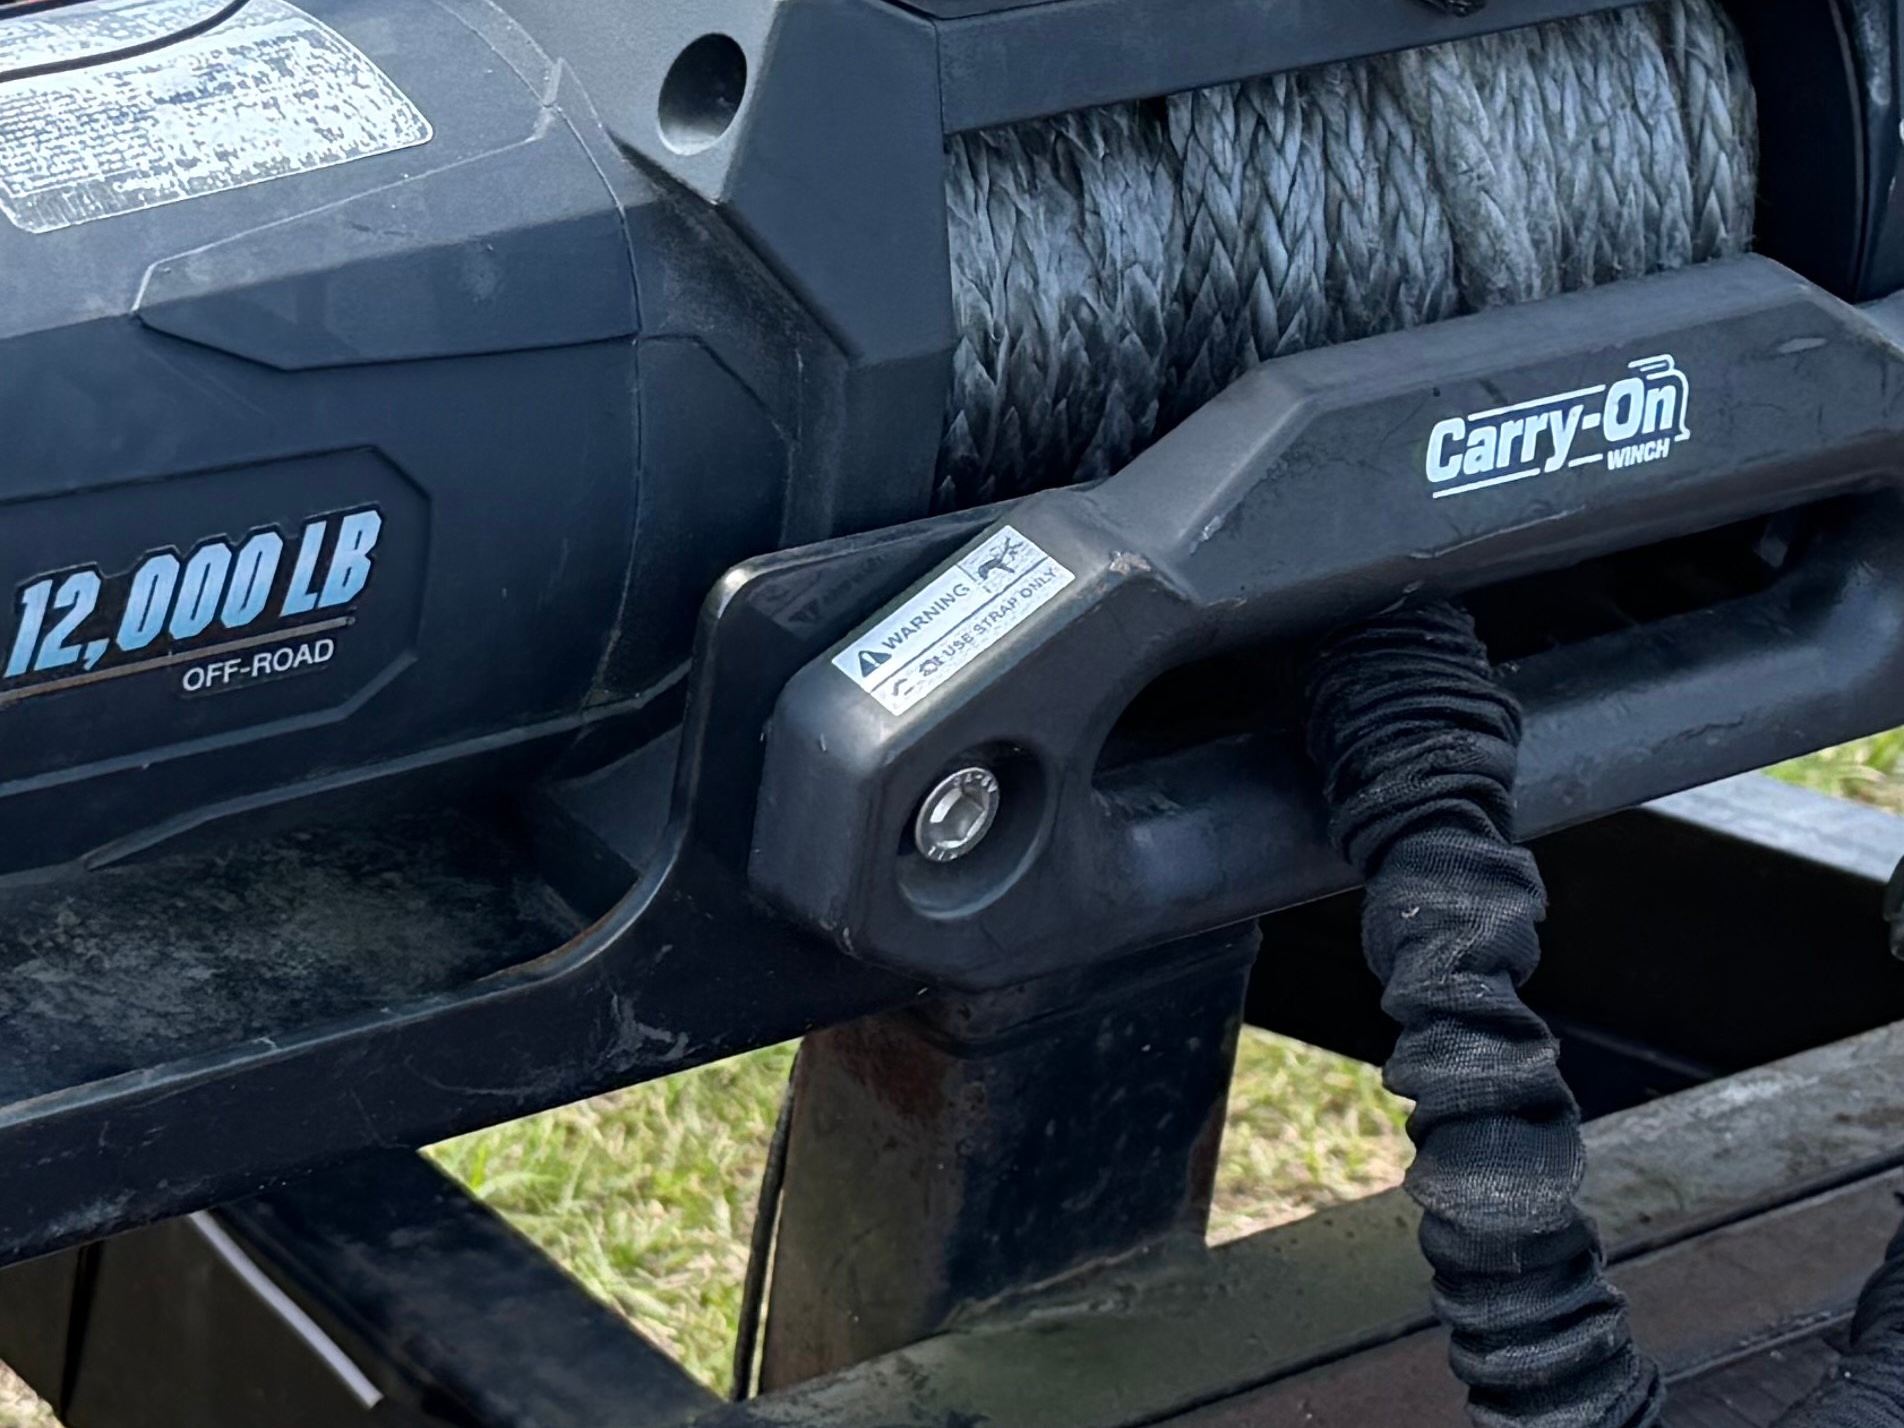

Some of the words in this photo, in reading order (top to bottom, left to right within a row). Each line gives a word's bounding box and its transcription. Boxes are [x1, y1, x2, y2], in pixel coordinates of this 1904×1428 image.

[1425, 377, 1678, 484] Carry-On
[1607, 438, 1671, 471] WINCH
[3, 531, 284, 671] 12,000
[281, 510, 383, 618] LB
[881, 582, 971, 651] WARNING
[942, 632, 975, 658] USE
[973, 596, 1018, 636] STRAP
[1019, 568, 1058, 600] ONLY
[182, 637, 335, 693] OFF-ROAD
